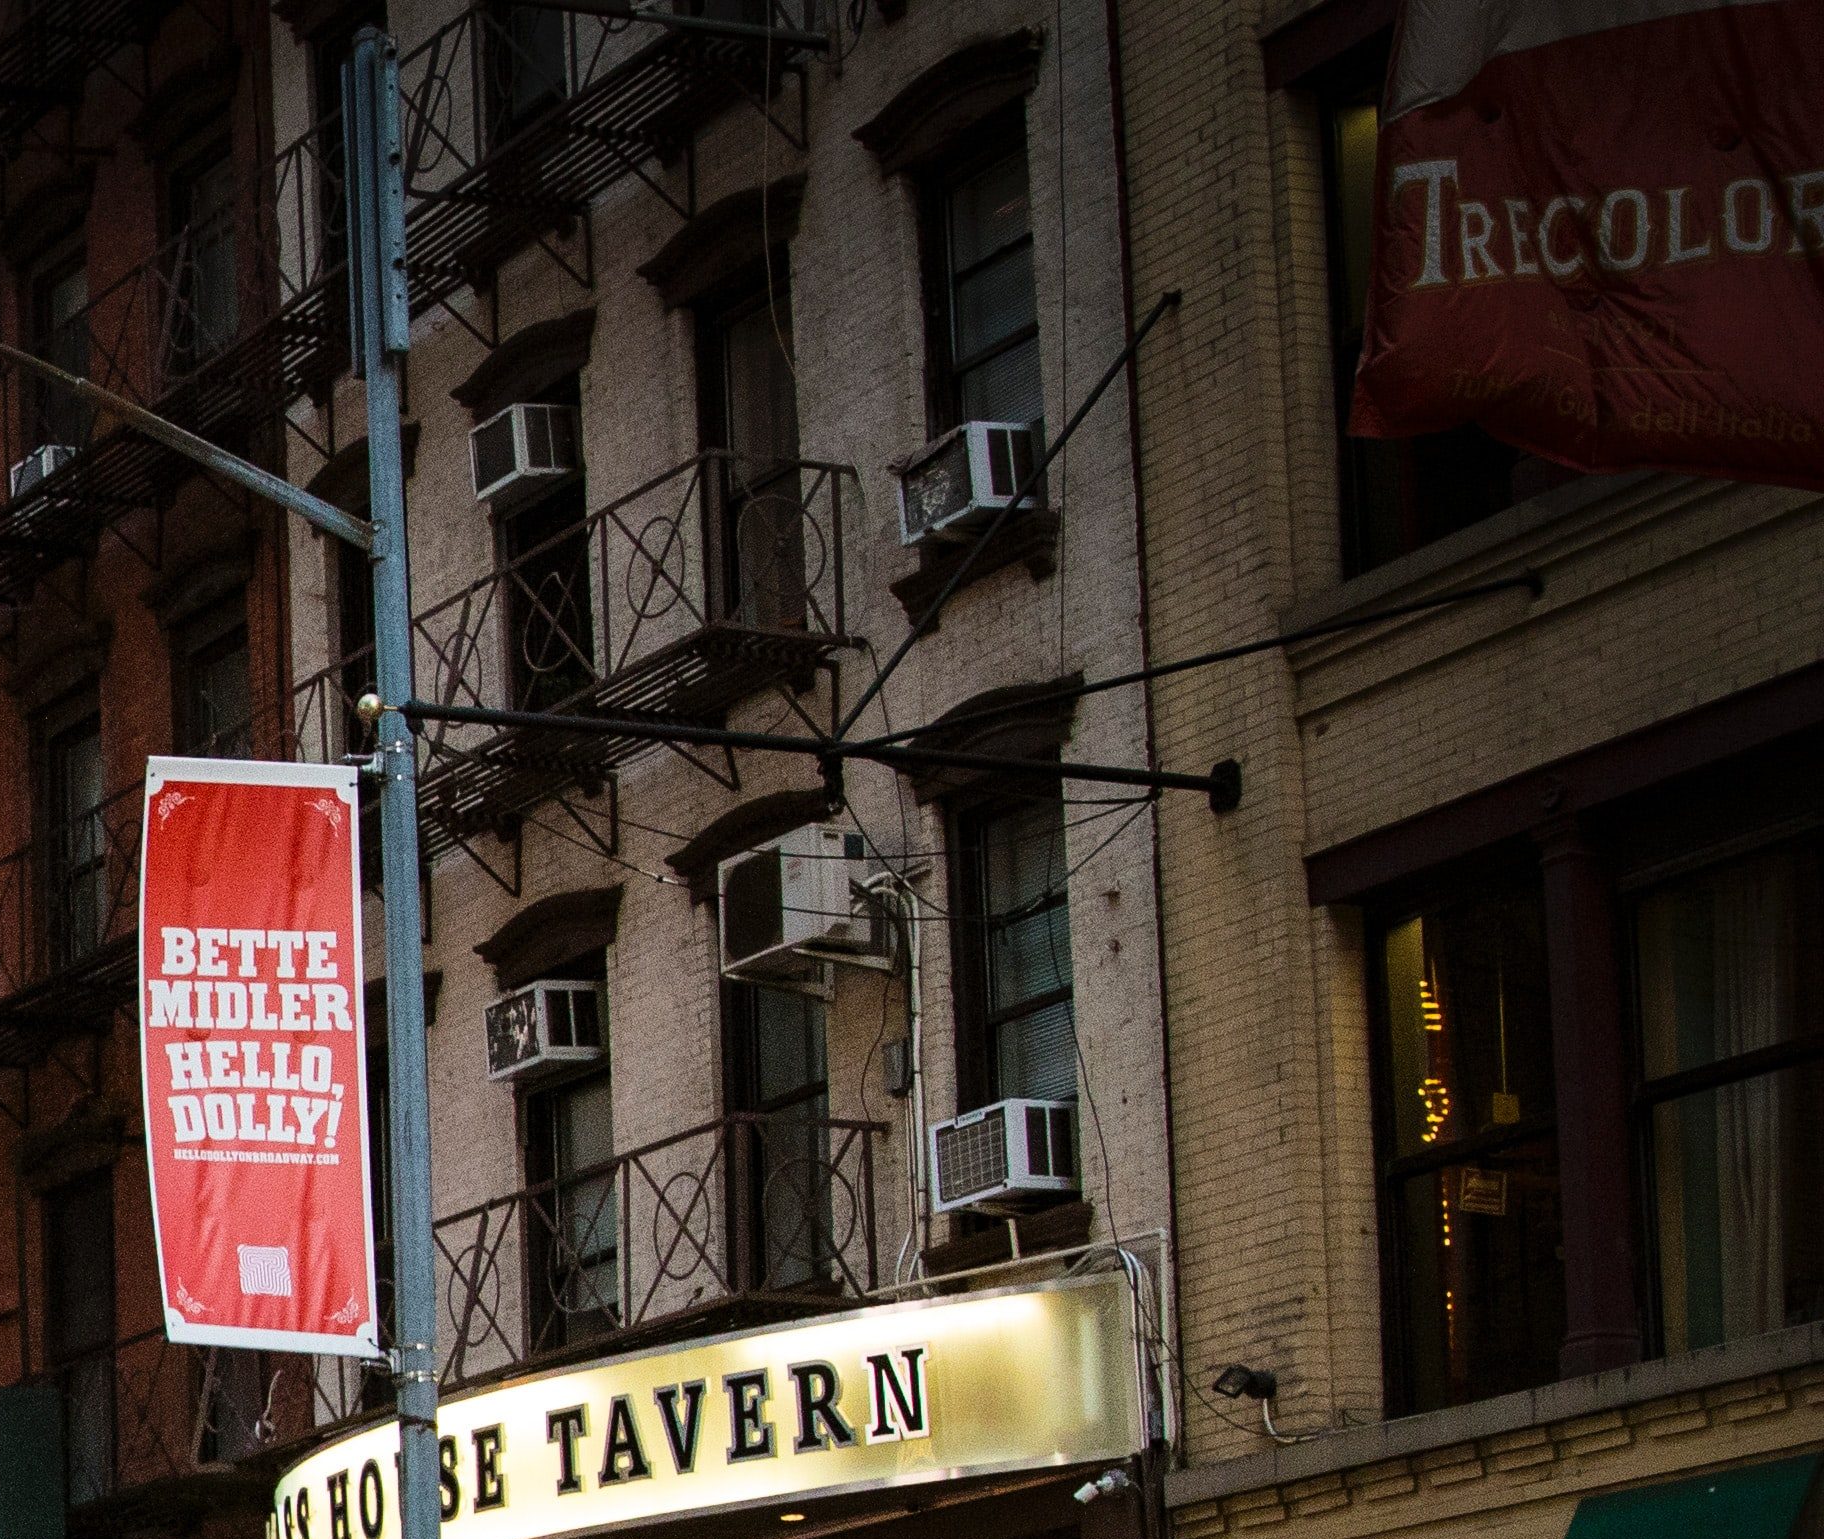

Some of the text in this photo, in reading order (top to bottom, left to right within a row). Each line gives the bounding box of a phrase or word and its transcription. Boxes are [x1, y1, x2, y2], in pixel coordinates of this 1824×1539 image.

[161, 927, 338, 979] BETTE
[148, 979, 352, 1031] MIDLER
[165, 1041, 345, 1097] HELLO,
[168, 1092, 343, 1149] DOLLY!
[545, 1341, 932, 1499] TAVERN
